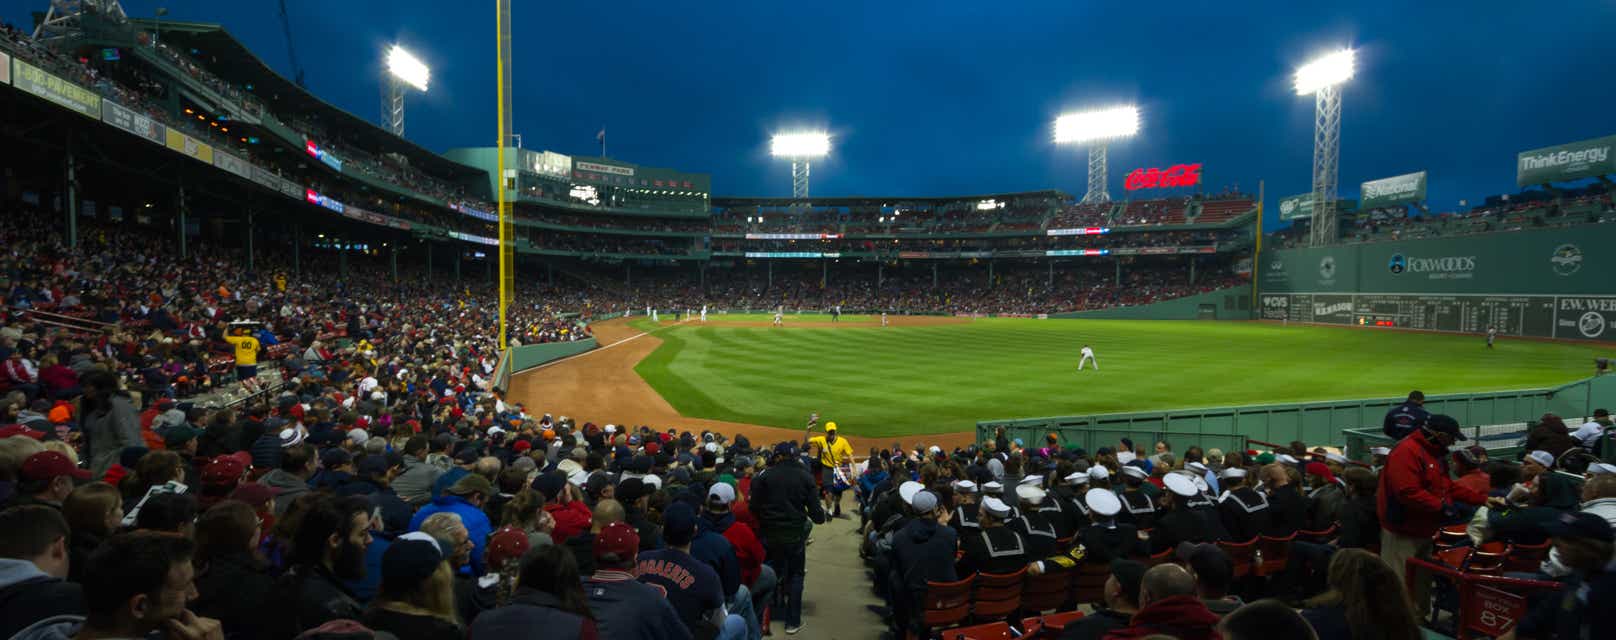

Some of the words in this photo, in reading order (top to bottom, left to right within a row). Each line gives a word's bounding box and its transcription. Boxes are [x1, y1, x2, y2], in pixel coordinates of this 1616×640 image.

[1522, 147, 1608, 170] ThinkEnergy
[1484, 600, 1510, 615] BOX
[1480, 610, 1512, 632] 87
